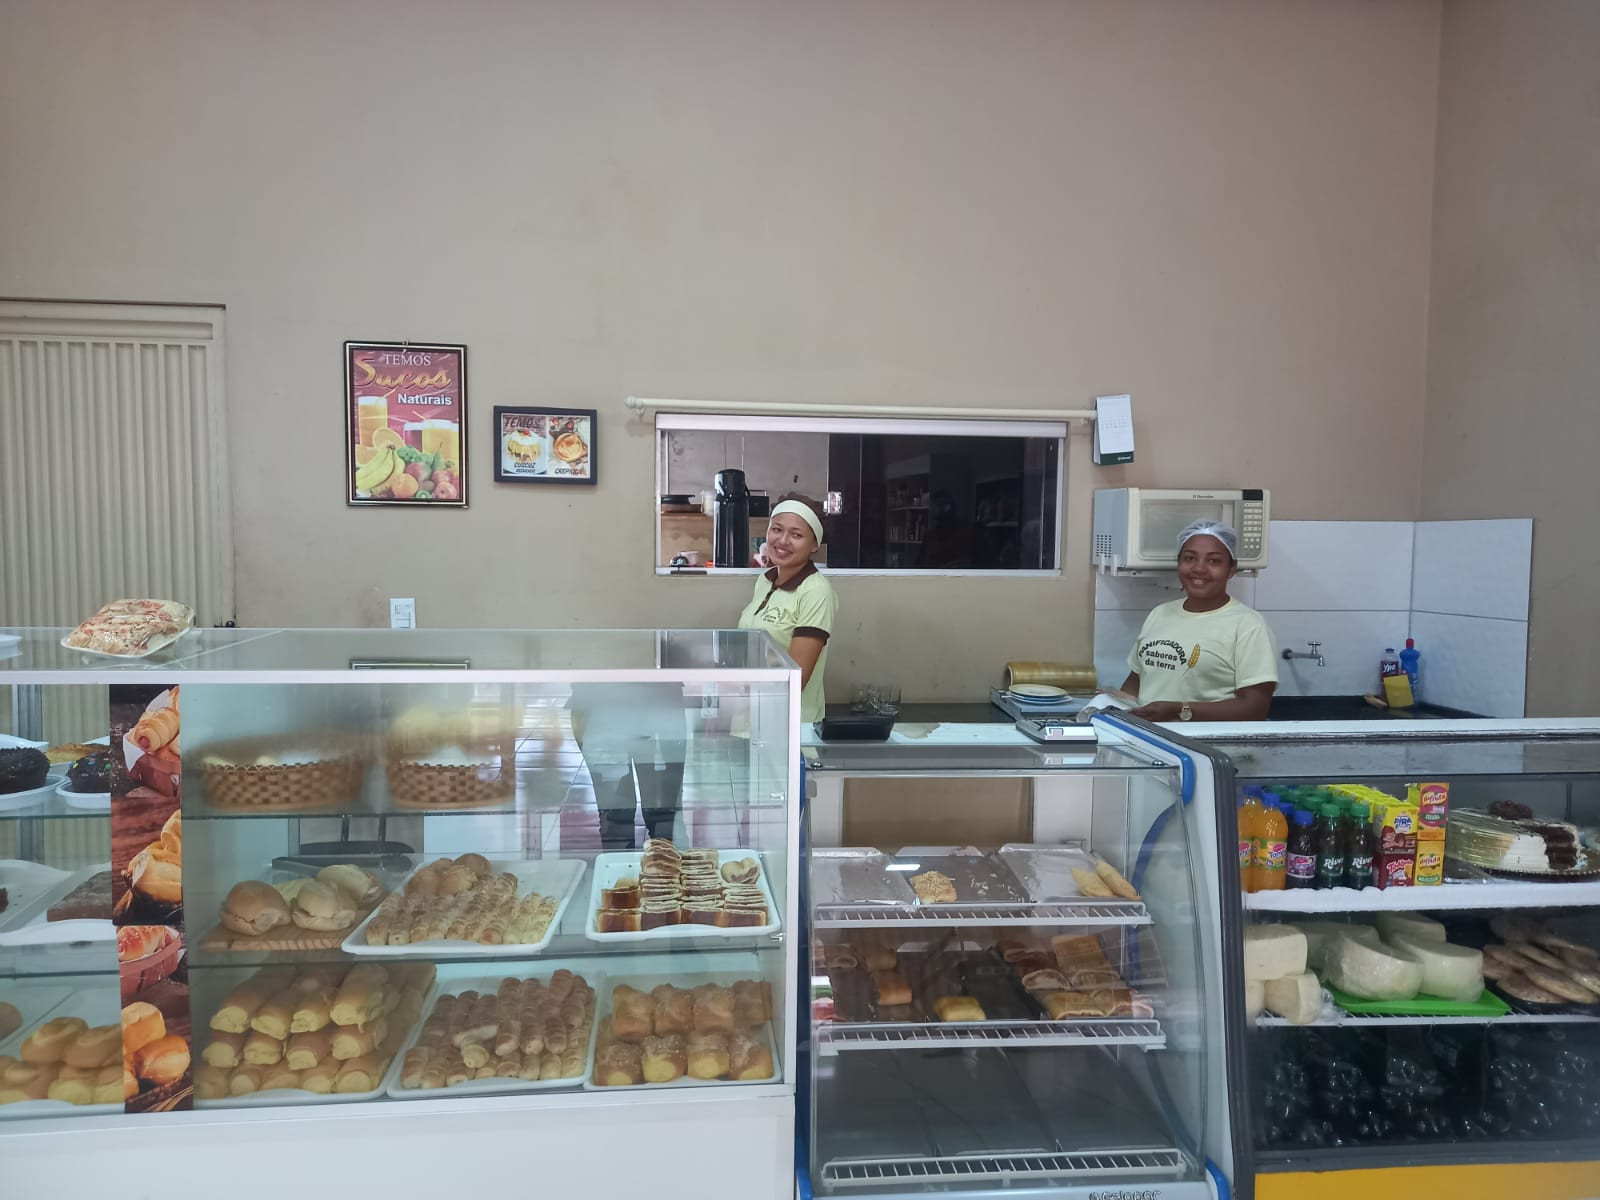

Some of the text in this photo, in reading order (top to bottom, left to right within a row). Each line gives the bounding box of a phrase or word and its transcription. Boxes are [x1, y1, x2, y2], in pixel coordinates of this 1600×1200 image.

[384, 354, 431, 366] TEMOS
[354, 356, 451, 389] Sucos
[397, 393, 452, 405] Naturais
[504, 417, 541, 428] TEMOS
[1139, 640, 1187, 665] PANIFICADORA
[1146, 650, 1177, 660] sabores
[1145, 658, 1175, 670] da terra
